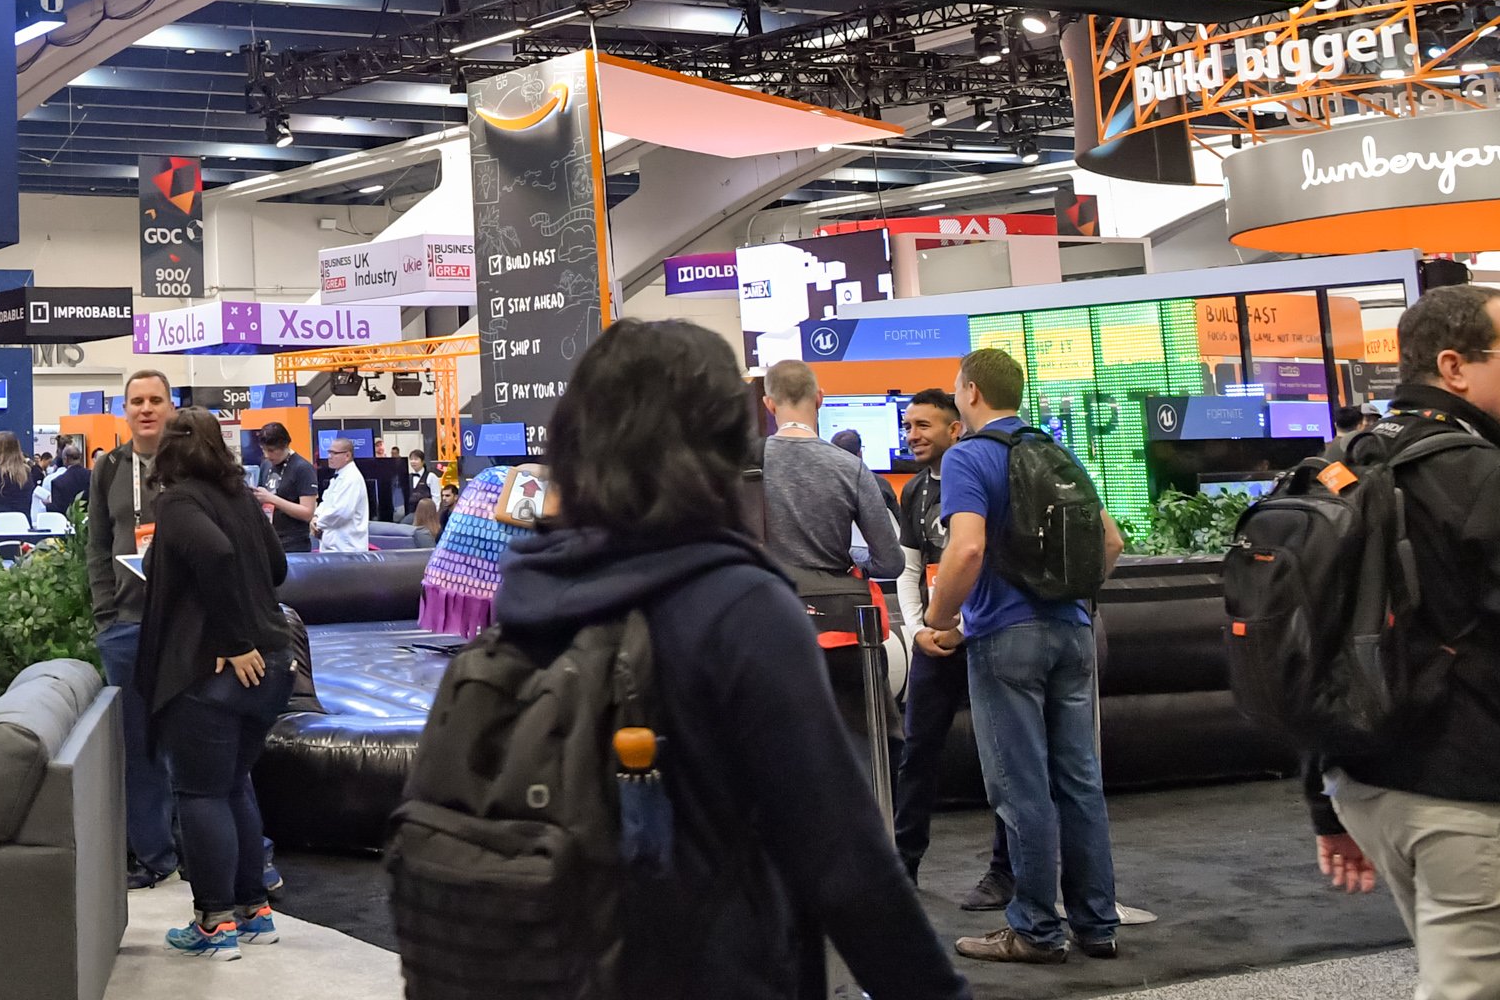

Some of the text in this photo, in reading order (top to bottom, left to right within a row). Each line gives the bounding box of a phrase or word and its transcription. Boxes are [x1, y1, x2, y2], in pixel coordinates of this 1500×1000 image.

[1134, 21, 1417, 107] Build bigger.
[1301, 135, 1500, 194] lumberyar
[144, 227, 183, 244] GDC
[324, 255, 351, 269] BUSINESS
[354, 252, 369, 269] UK
[435, 254, 443, 264] IS
[505, 248, 556, 271] BUILD FAST
[155, 267, 191, 282] 900/
[324, 268, 330, 278] IS
[354, 268, 398, 287] Industry
[436, 266, 469, 277] GREAT
[695, 264, 739, 279] DOLBY
[155, 282, 191, 295] 1000
[326, 278, 346, 289] GREAT
[508, 292, 565, 314] STAY AHEAD
[53, 305, 131, 319] IMPROBABLE
[157, 312, 205, 346] Xsolla
[279, 309, 370, 340] Xsolla
[884, 328, 941, 341] FORTNITE
[510, 338, 541, 357] SHIP IT
[223, 389, 250, 406] Spat
[512, 383, 530, 399] PAY
[533, 381, 556, 399] YOUR
[1206, 408, 1244, 420] FORTNITE
